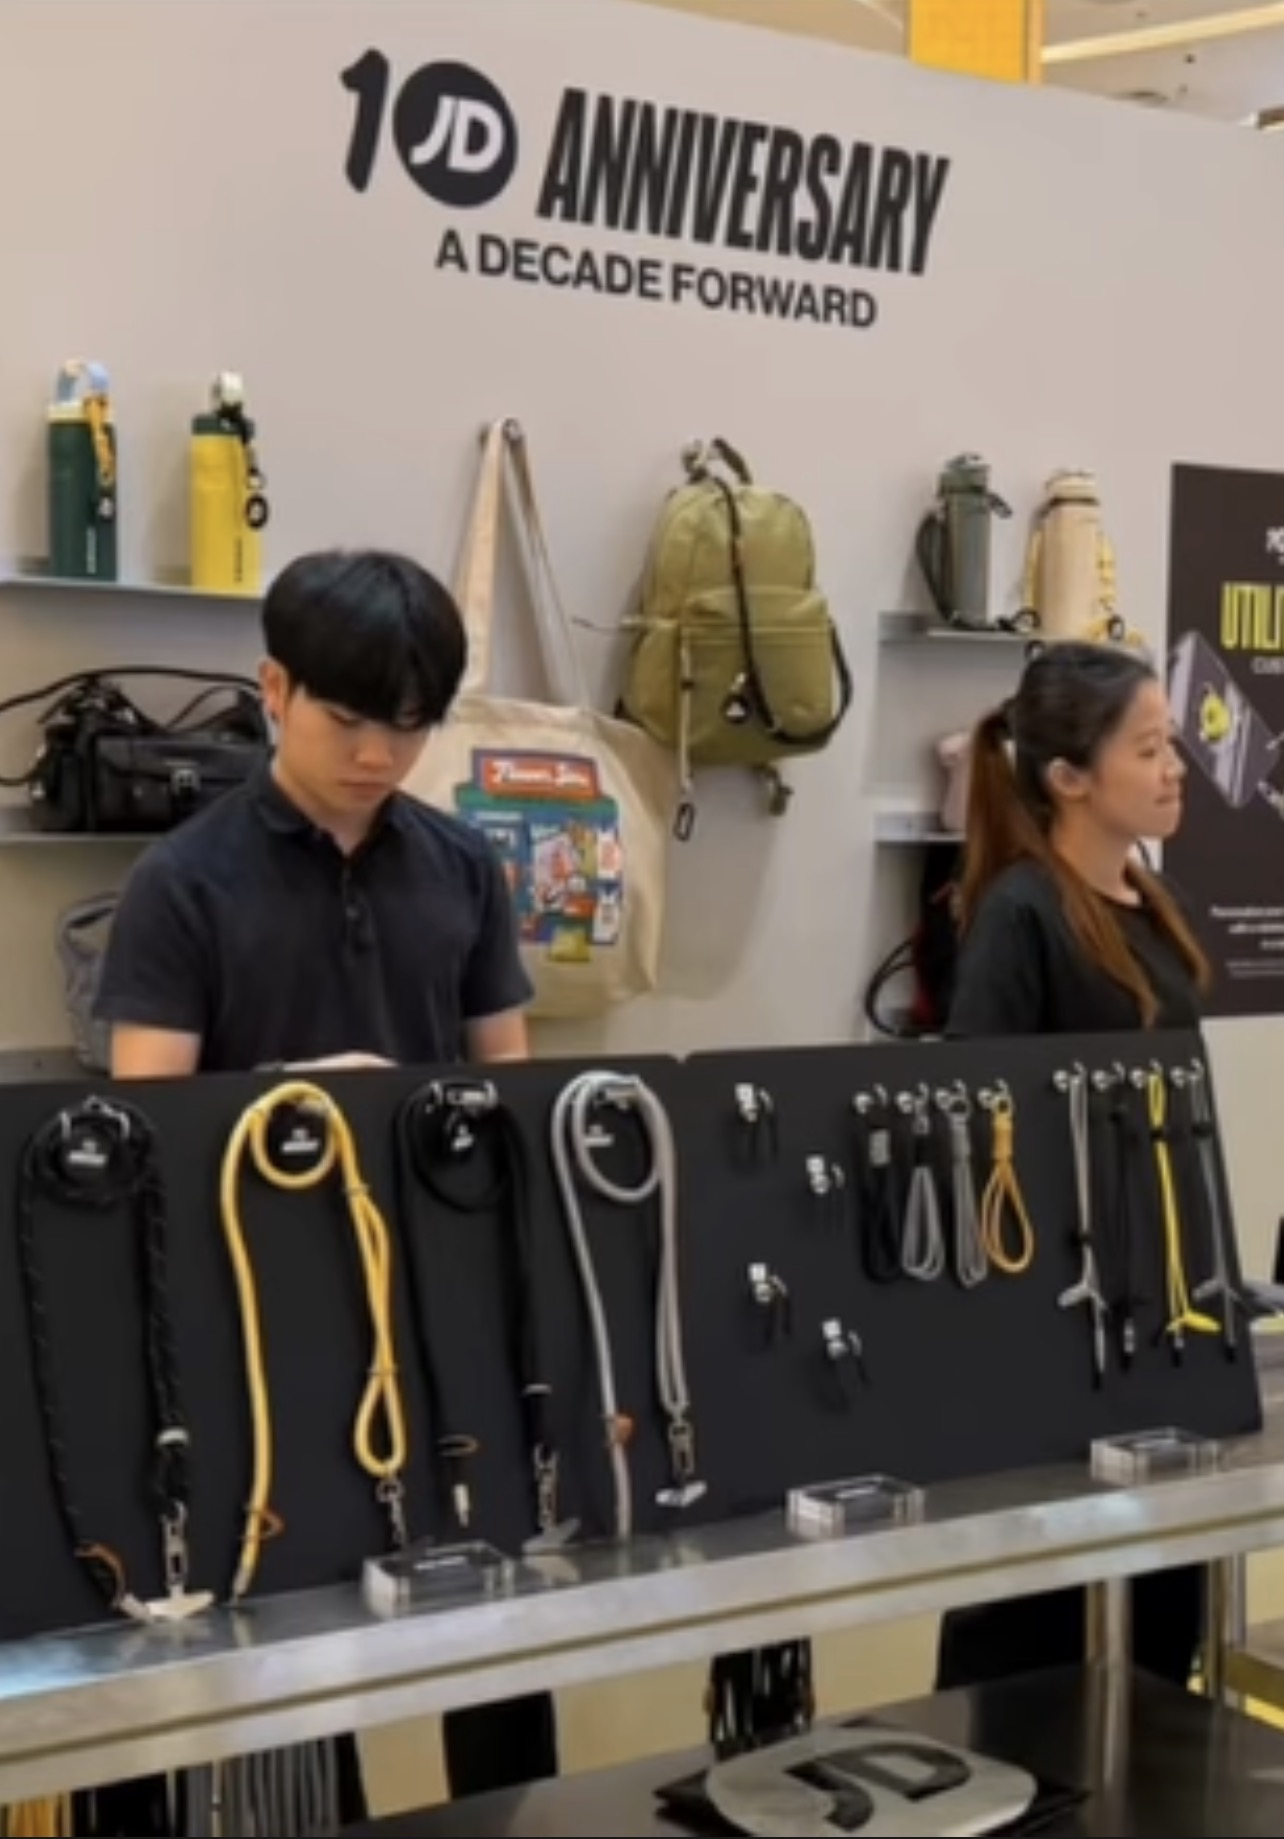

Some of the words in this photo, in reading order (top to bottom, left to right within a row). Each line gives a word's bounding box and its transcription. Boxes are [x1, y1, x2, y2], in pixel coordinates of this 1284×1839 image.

[410, 96, 503, 172] JD
[536, 87, 950, 276] ANNIVERSARY
[436, 229, 469, 272] A
[478, 233, 662, 300] DECADE
[671, 263, 877, 328] FORWARD
[785, 1742, 973, 1832] JD
